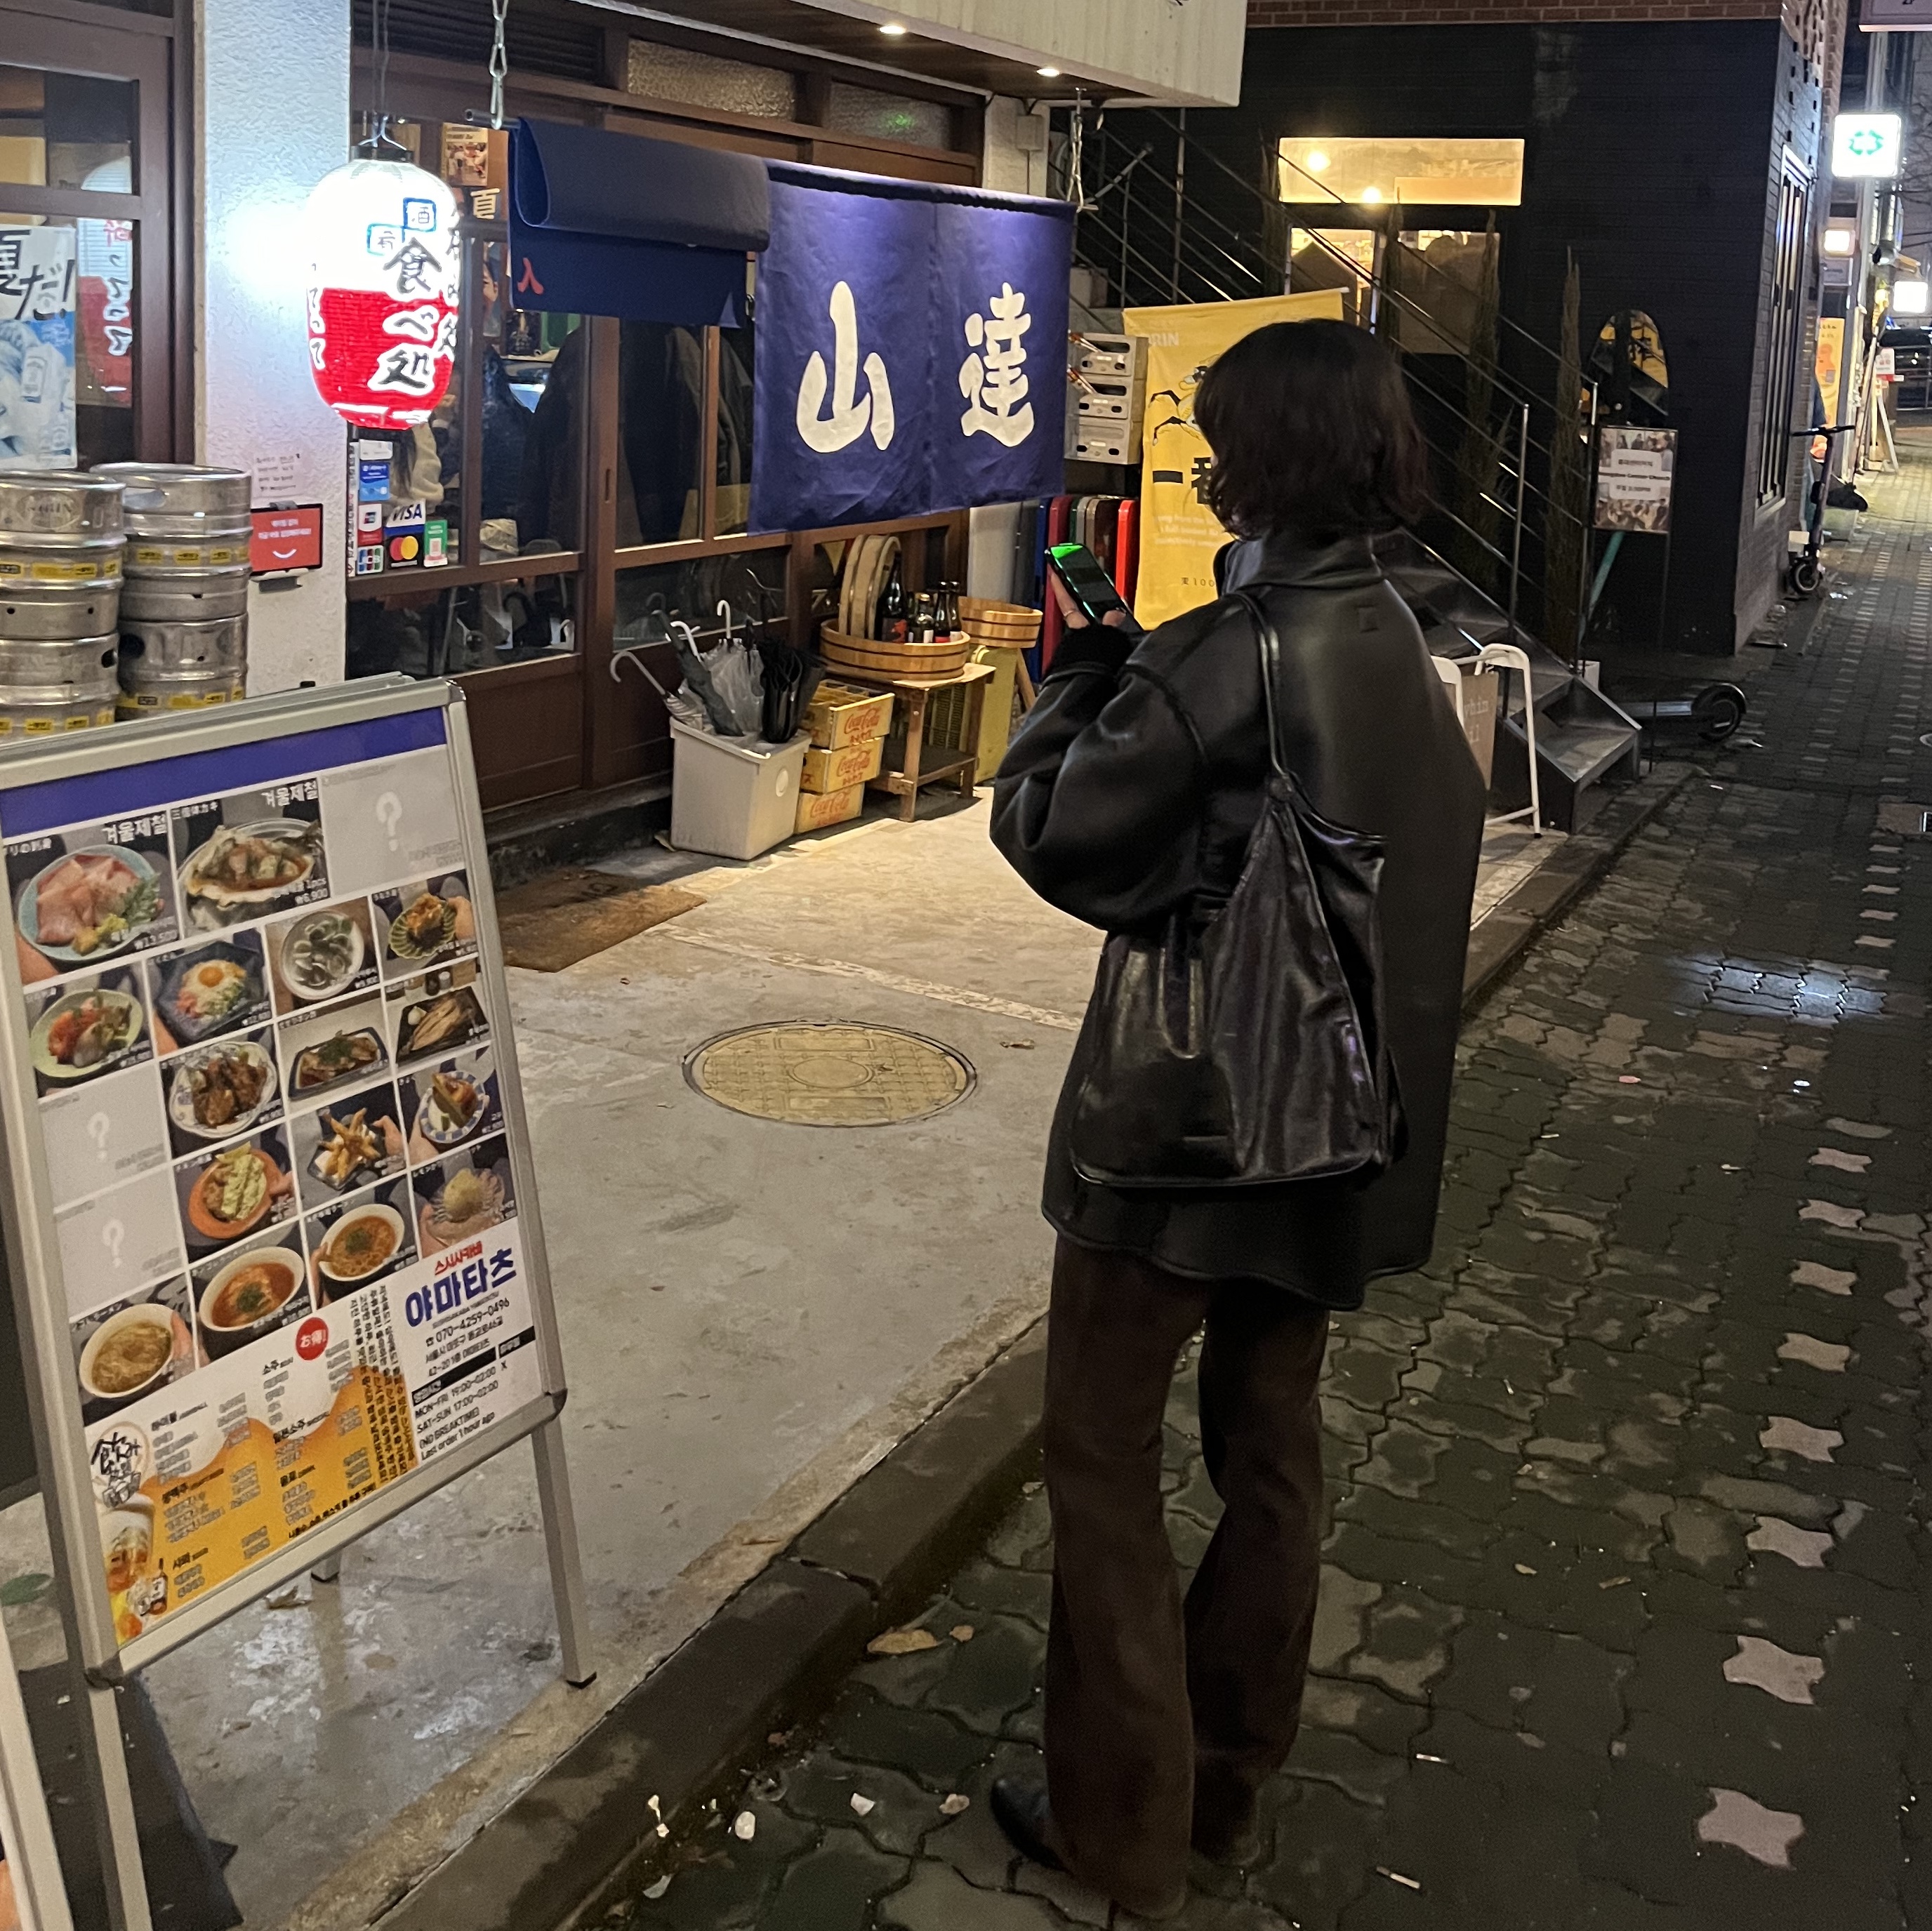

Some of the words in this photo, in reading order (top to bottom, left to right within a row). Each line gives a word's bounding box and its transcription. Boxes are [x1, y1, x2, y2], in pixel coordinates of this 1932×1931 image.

[392, 503, 423, 523] VISA
[260, 781, 318, 810] 겨울제철
[102, 813, 167, 846] 겨울제철
[404, 1243, 517, 1331] 야마타츠
[435, 1296, 509, 1343] 070-4259-0496
